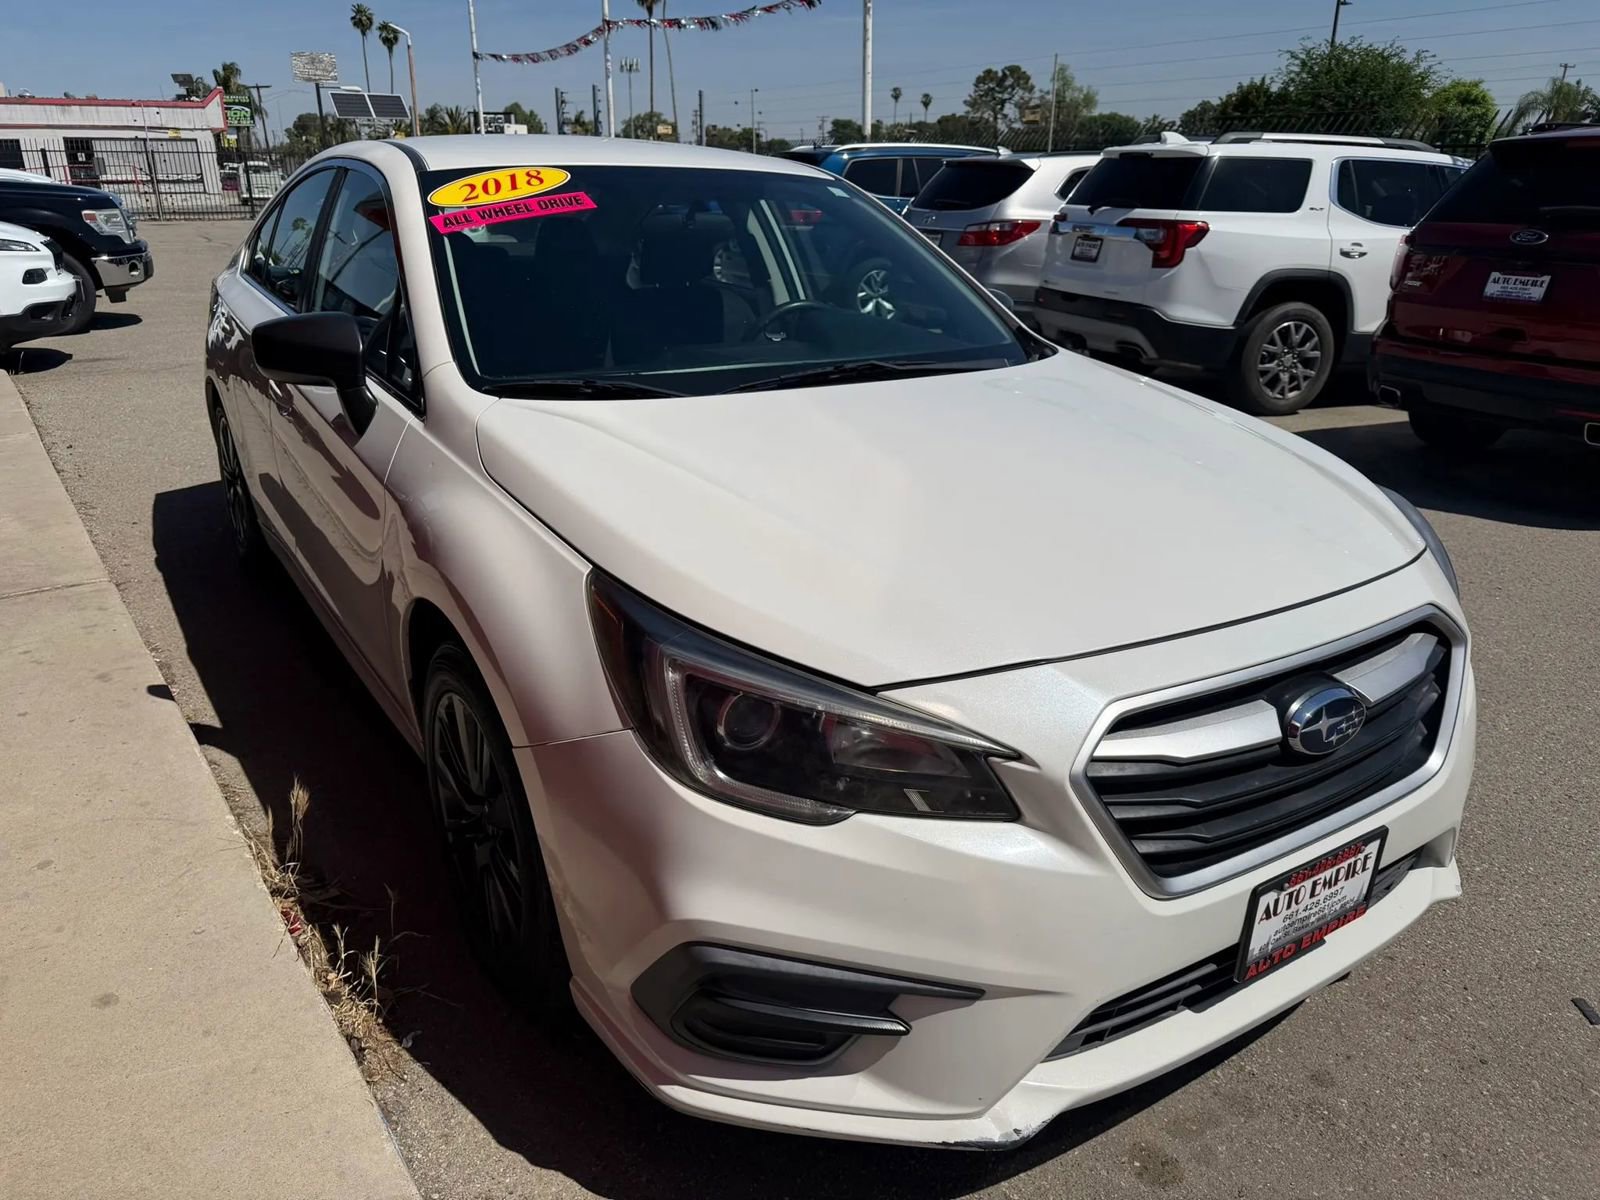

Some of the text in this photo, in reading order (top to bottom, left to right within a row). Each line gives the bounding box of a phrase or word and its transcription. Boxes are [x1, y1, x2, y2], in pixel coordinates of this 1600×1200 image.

[458, 169, 545, 203] 2018
[443, 194, 585, 228] ALL WHEEL DRIVE
[1258, 851, 1373, 925] AUTO EMPIRE
[1282, 886, 1345, 924] 661.428.6997
[1244, 942, 1297, 981] AUTO
